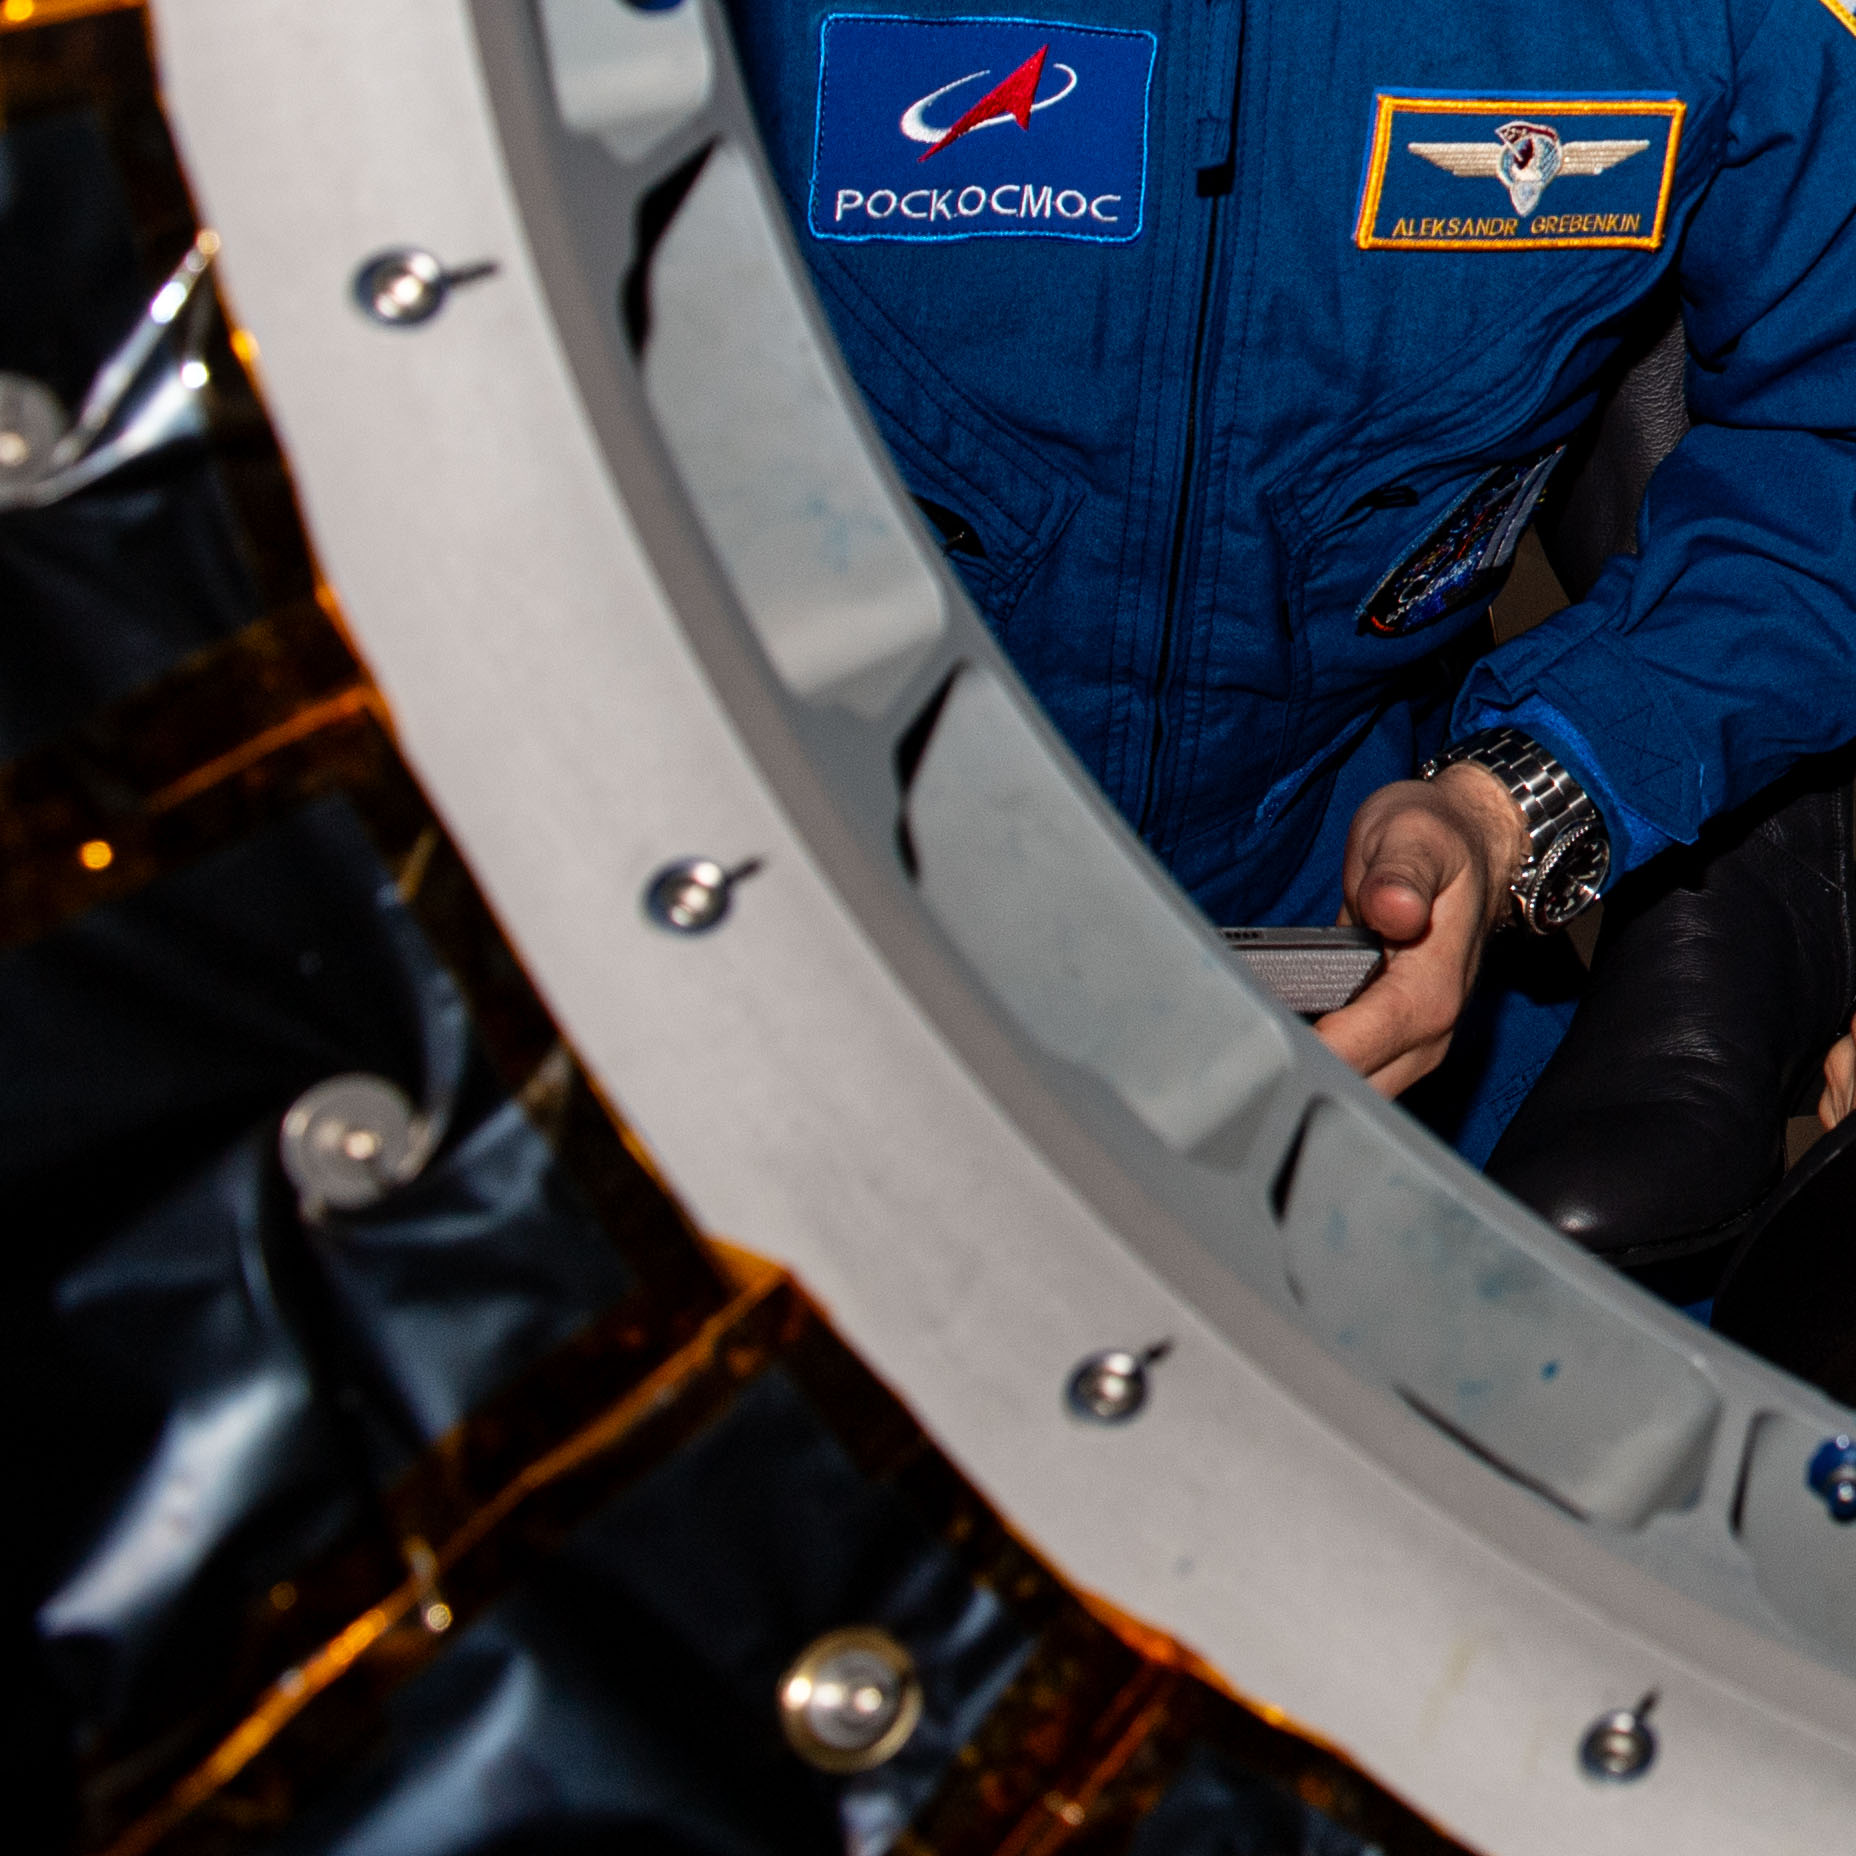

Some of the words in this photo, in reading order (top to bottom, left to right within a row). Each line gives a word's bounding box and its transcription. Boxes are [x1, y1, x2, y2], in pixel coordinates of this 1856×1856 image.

[835, 184, 1121, 223] РОСКОСМОС
[1392, 217, 1518, 237] ALEKSANDR
[1530, 213, 1642, 235] GREBENKIN
